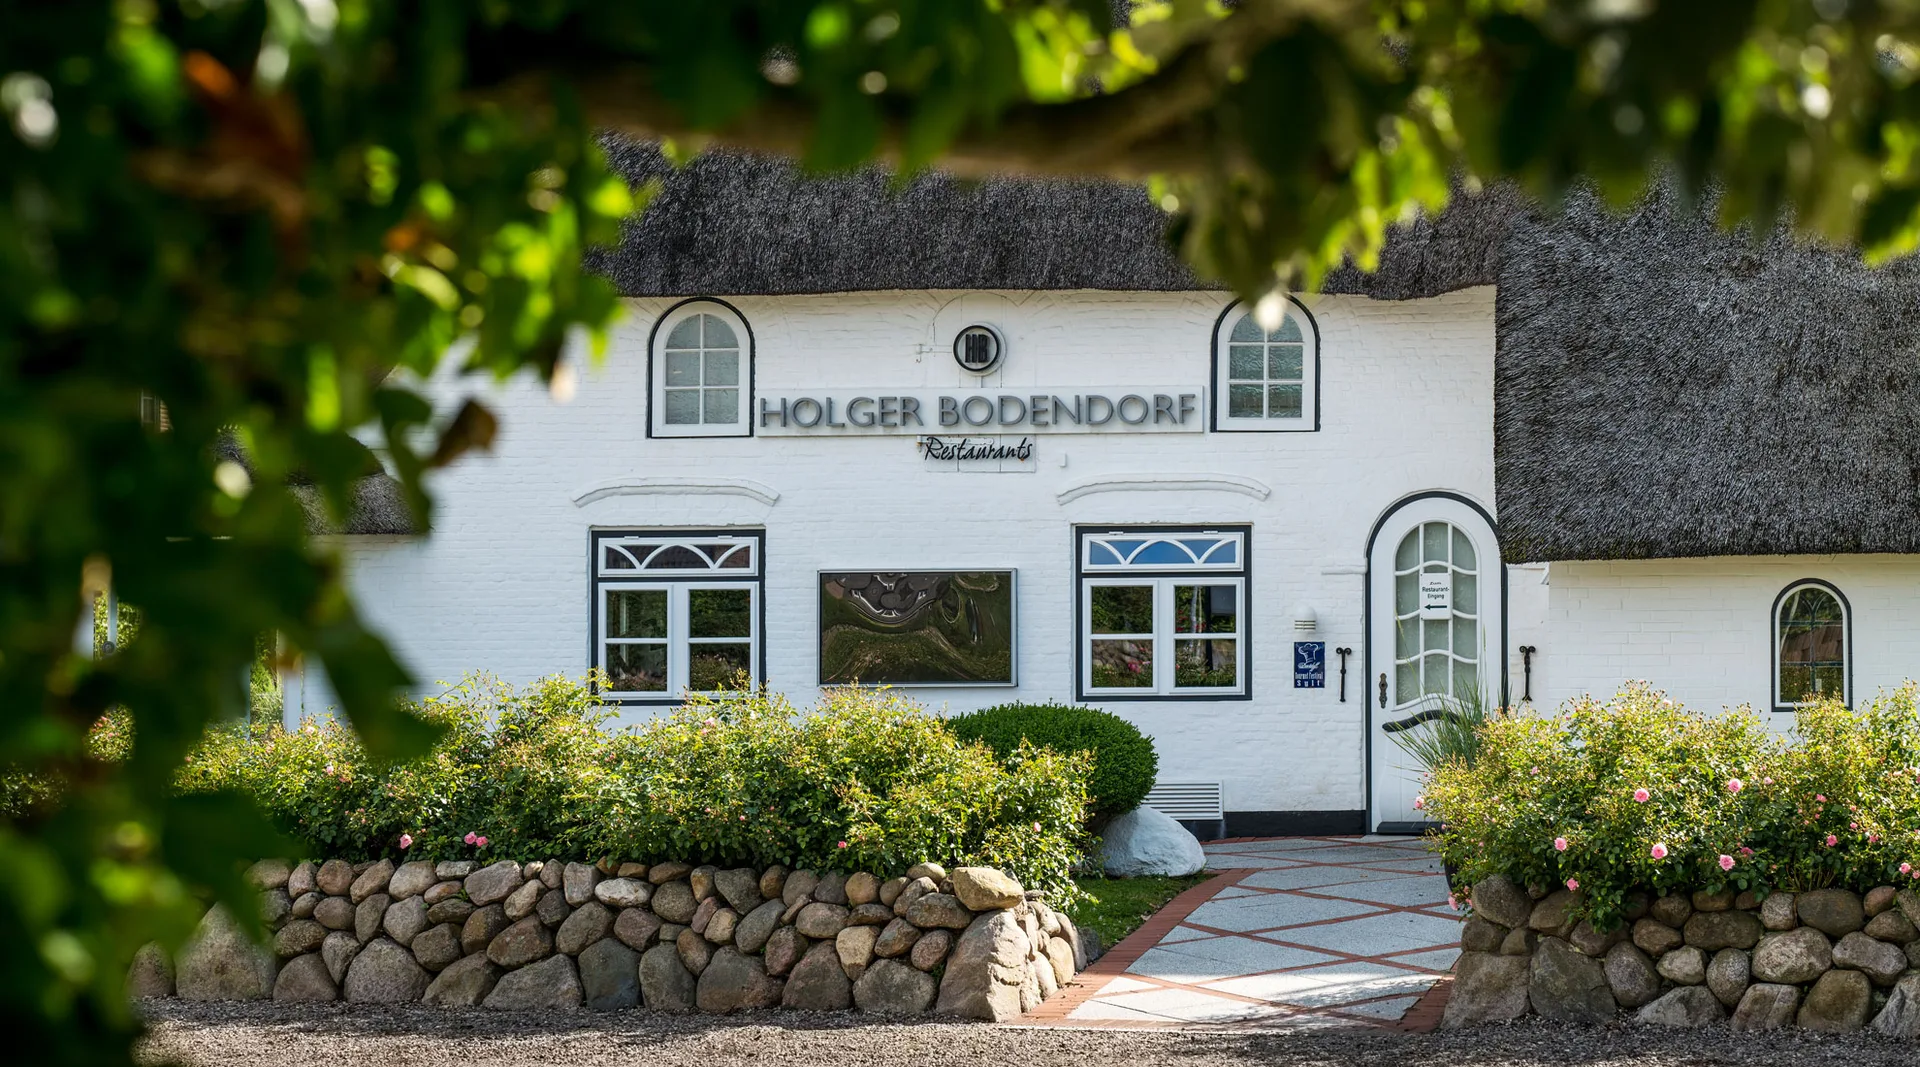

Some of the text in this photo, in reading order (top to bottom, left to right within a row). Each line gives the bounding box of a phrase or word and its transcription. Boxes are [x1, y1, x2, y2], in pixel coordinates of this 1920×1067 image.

[760, 394, 1196, 428] HOLGER BODENDORF
[924, 436, 1032, 461] Restaurants
